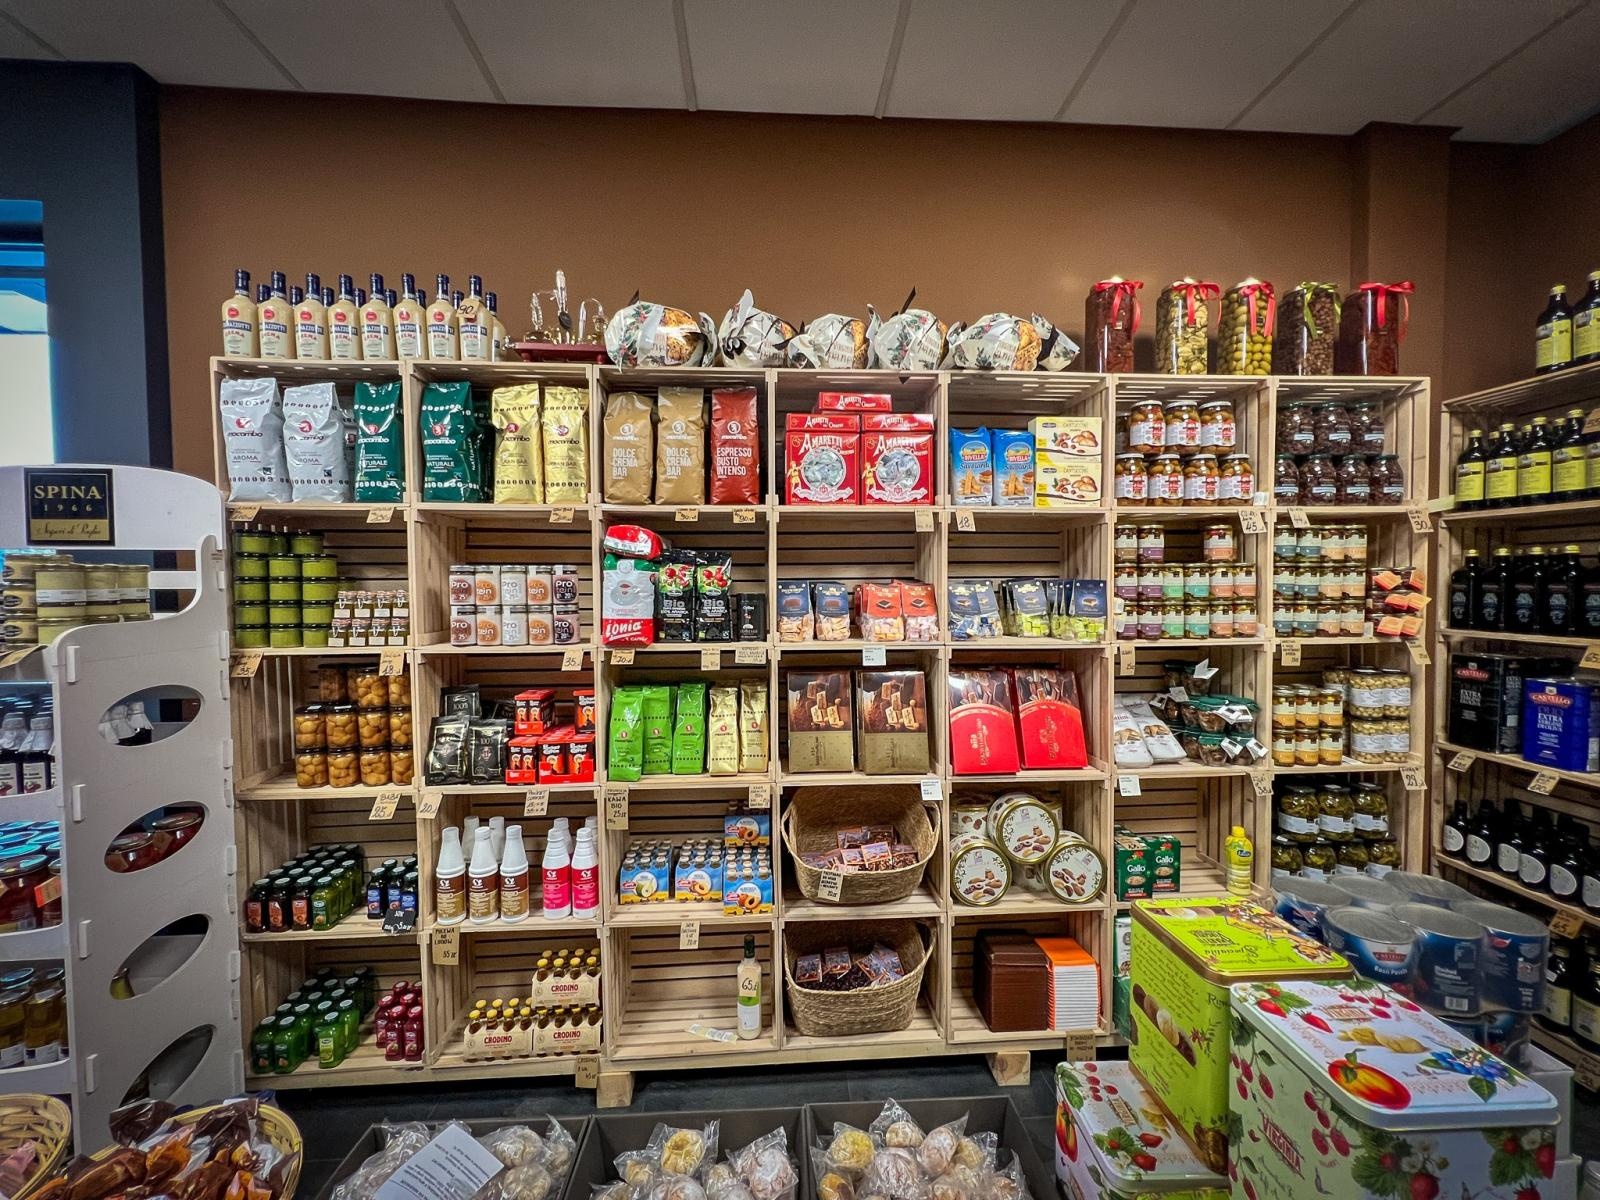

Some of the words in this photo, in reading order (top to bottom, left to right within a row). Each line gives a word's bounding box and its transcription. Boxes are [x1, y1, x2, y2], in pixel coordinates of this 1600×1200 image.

[799, 433, 843, 456] AMARETTI
[613, 448, 636, 458] DOLCE
[666, 448, 689, 458] DOLCE
[717, 448, 752, 458] ESPRESSO
[613, 457, 638, 467] CREMA
[666, 457, 692, 467] CREMA
[717, 457, 739, 466] GUSTO
[613, 466, 627, 477] BAR
[666, 466, 681, 476] BAR
[717, 466, 746, 476] INTENSO
[33, 485, 103, 500] SPINA
[663, 600, 685, 608] Bio
[704, 599, 724, 607] Bio
[1532, 694, 1571, 706] CASTELLO
[1538, 712, 1563, 723] EXTRA
[1127, 864, 1146, 872] Gallo
[551, 984, 578, 993] CRODINO
[484, 1036, 512, 1044] CRODINO
[553, 1031, 581, 1039] CRODINO
